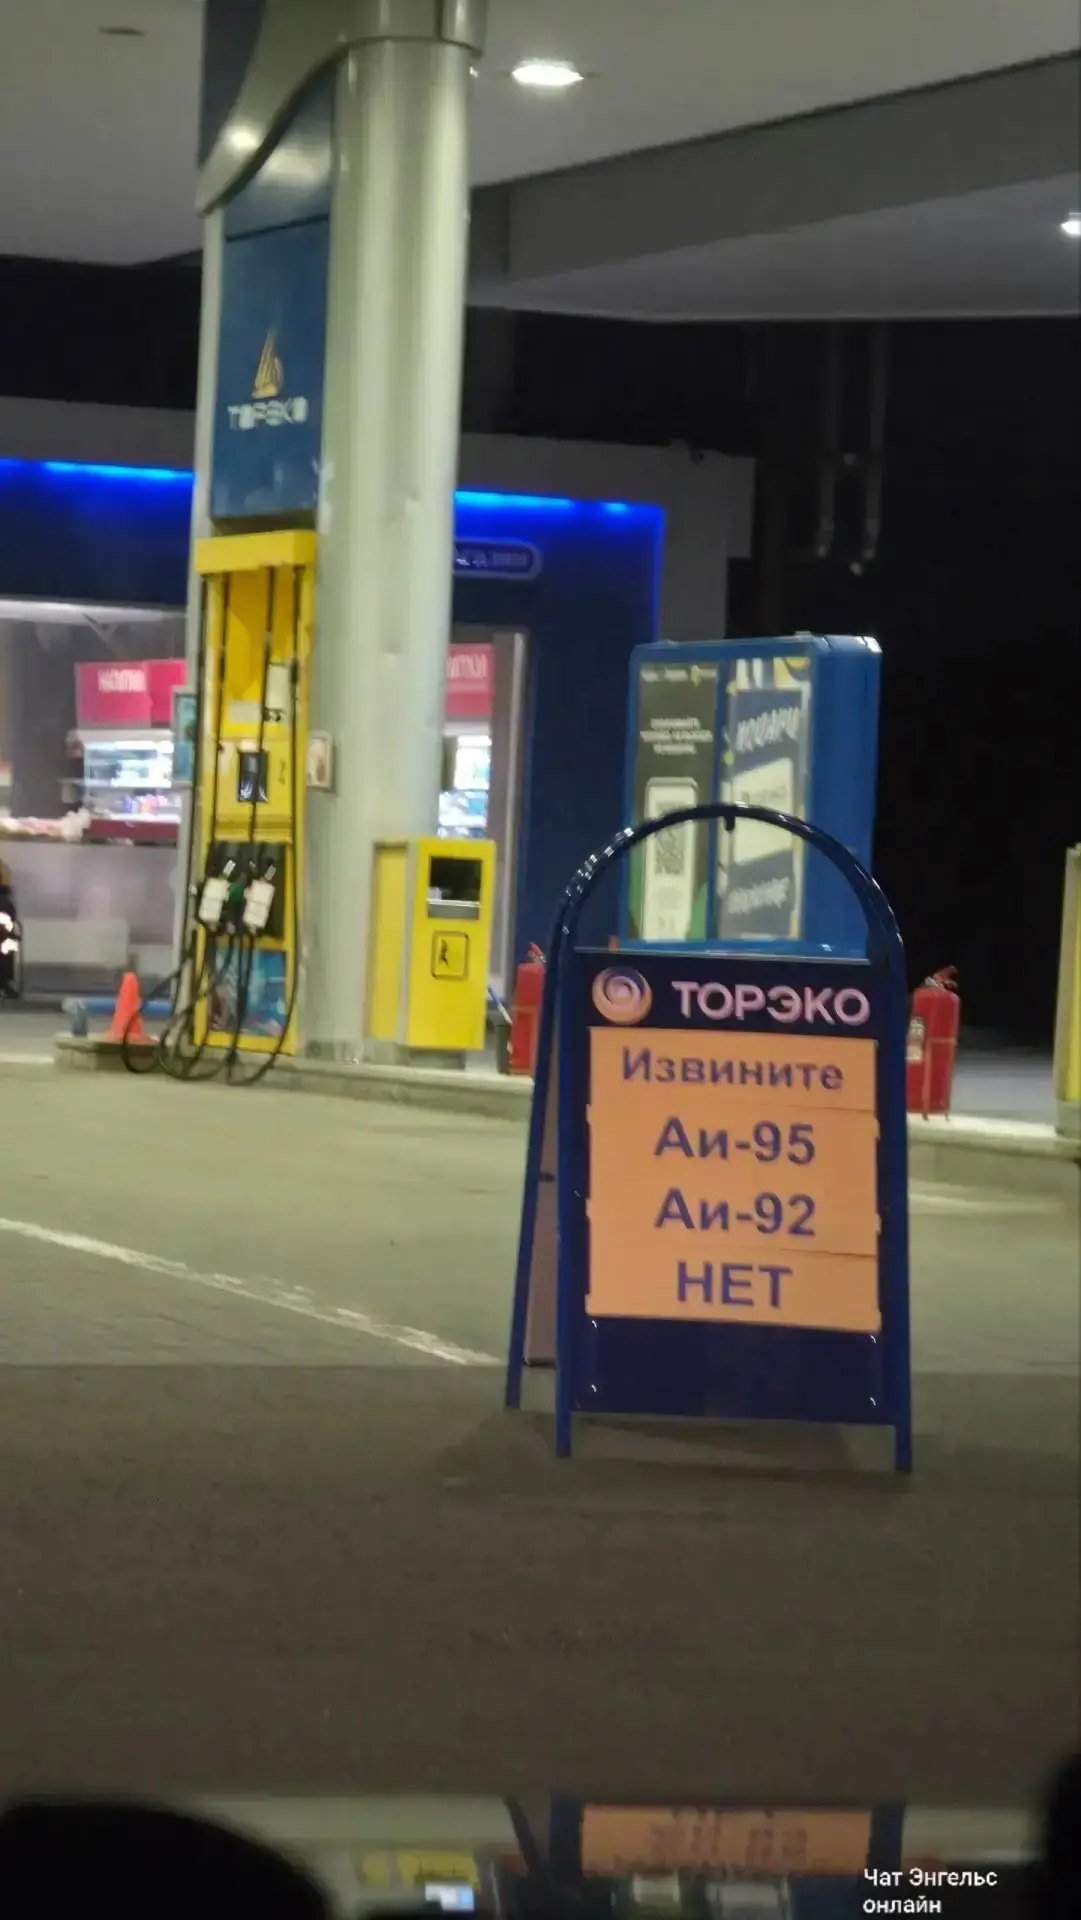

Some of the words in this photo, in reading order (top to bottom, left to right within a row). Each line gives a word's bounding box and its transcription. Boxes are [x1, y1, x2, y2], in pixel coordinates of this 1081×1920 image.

[671, 980, 871, 1026] ТОРЭКО
[622, 1047, 844, 1091] Извините
[654, 1116, 816, 1164] Аи-95
[654, 1188, 816, 1236] Аи-92
[676, 1261, 793, 1309] НЕТ
